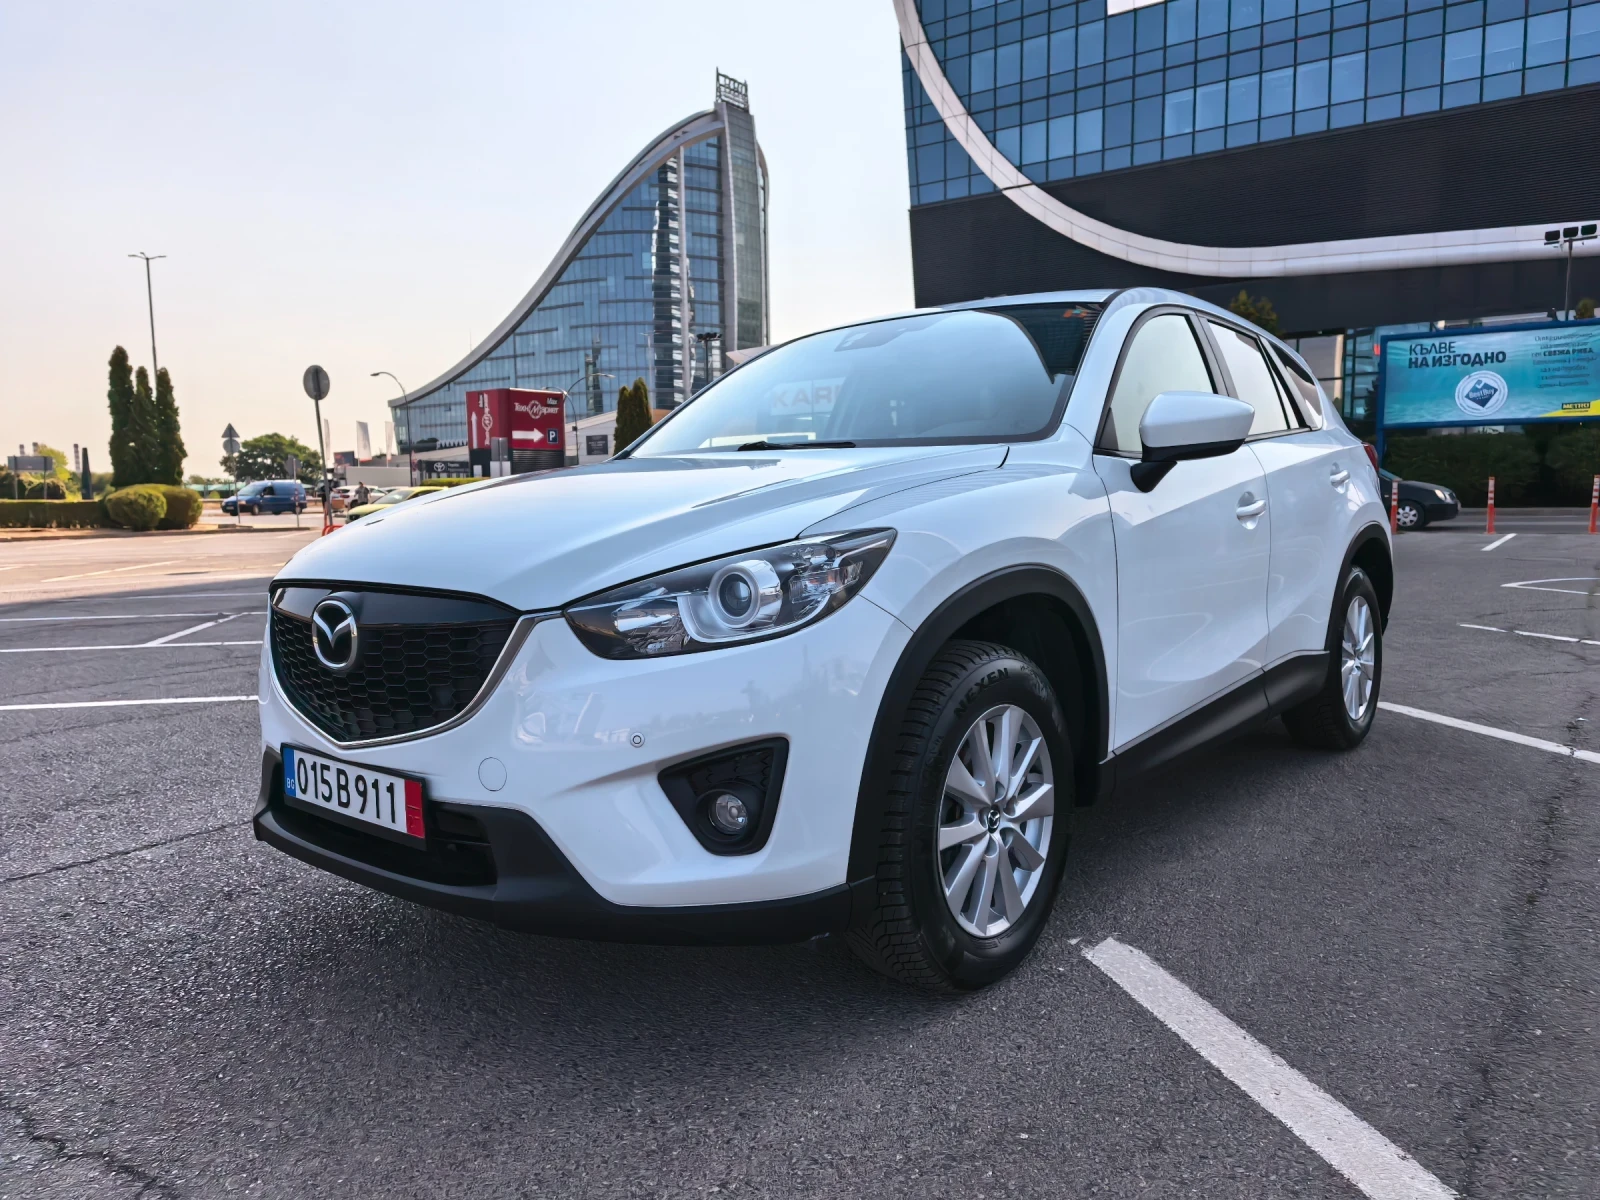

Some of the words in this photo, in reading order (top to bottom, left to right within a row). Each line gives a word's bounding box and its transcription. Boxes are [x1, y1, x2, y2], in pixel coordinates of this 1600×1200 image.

[1409, 341, 1456, 356] КЪЛВЕ
[1408, 356, 1429, 369] НА
[1432, 351, 1507, 368] ИЗГОДНО
[954, 667, 1010, 717] NEXEN
[286, 777, 295, 790] BG
[297, 757, 396, 824] 015B911
